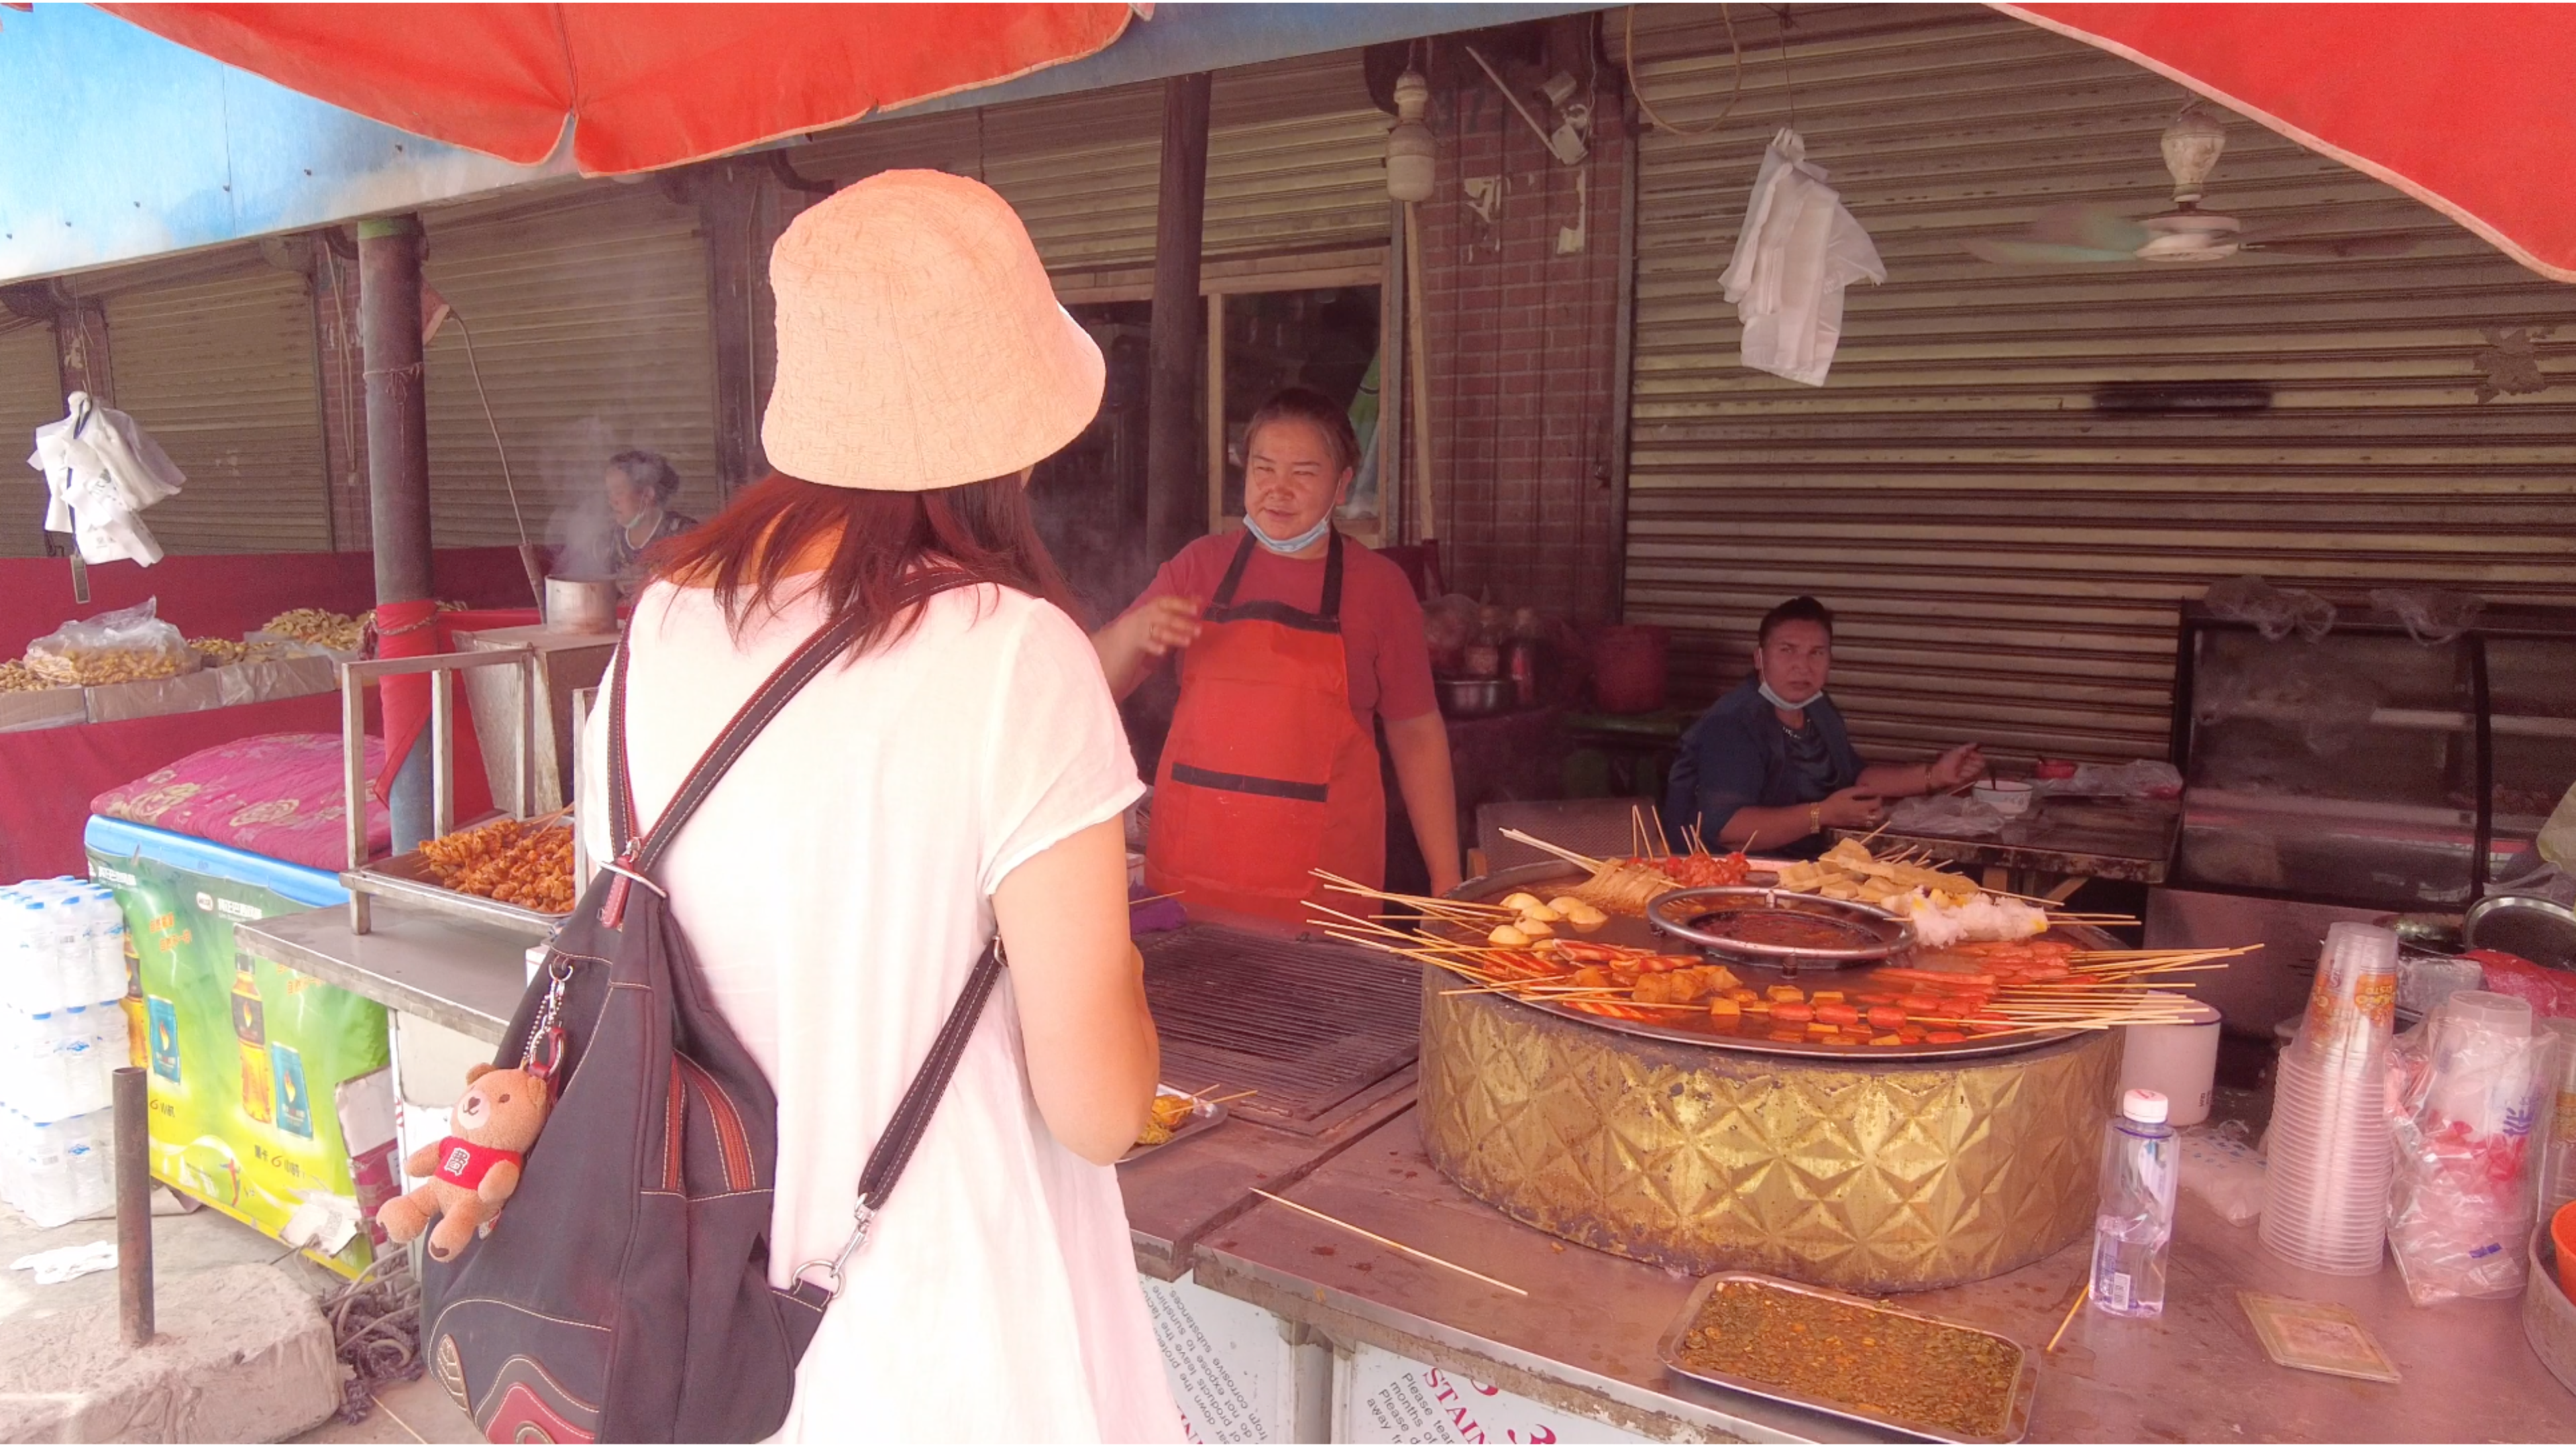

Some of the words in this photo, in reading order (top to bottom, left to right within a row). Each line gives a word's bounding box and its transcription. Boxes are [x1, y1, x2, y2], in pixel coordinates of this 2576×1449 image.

[1152, 1285, 1186, 1335] sunshine
[1161, 1322, 1175, 1342] the
[1186, 1339, 1196, 1352] to
[1175, 1344, 1197, 1375] leave
[1197, 1354, 1225, 1396] expose
[1179, 1373, 1193, 1392] the
[1213, 1358, 1248, 1409] corrosive
[1401, 1373, 1433, 1416] Please
[1194, 1395, 1215, 1425] down
[1197, 1378, 1232, 1427] products
[1224, 1399, 1240, 1419] not
[1366, 1398, 1391, 1430] away
[1379, 1389, 1409, 1432] Please
[1389, 1381, 1424, 1428] months
[1229, 1431, 1240, 1442] of
[1240, 1423, 1252, 1438] do
[1248, 1413, 1268, 1440] from
